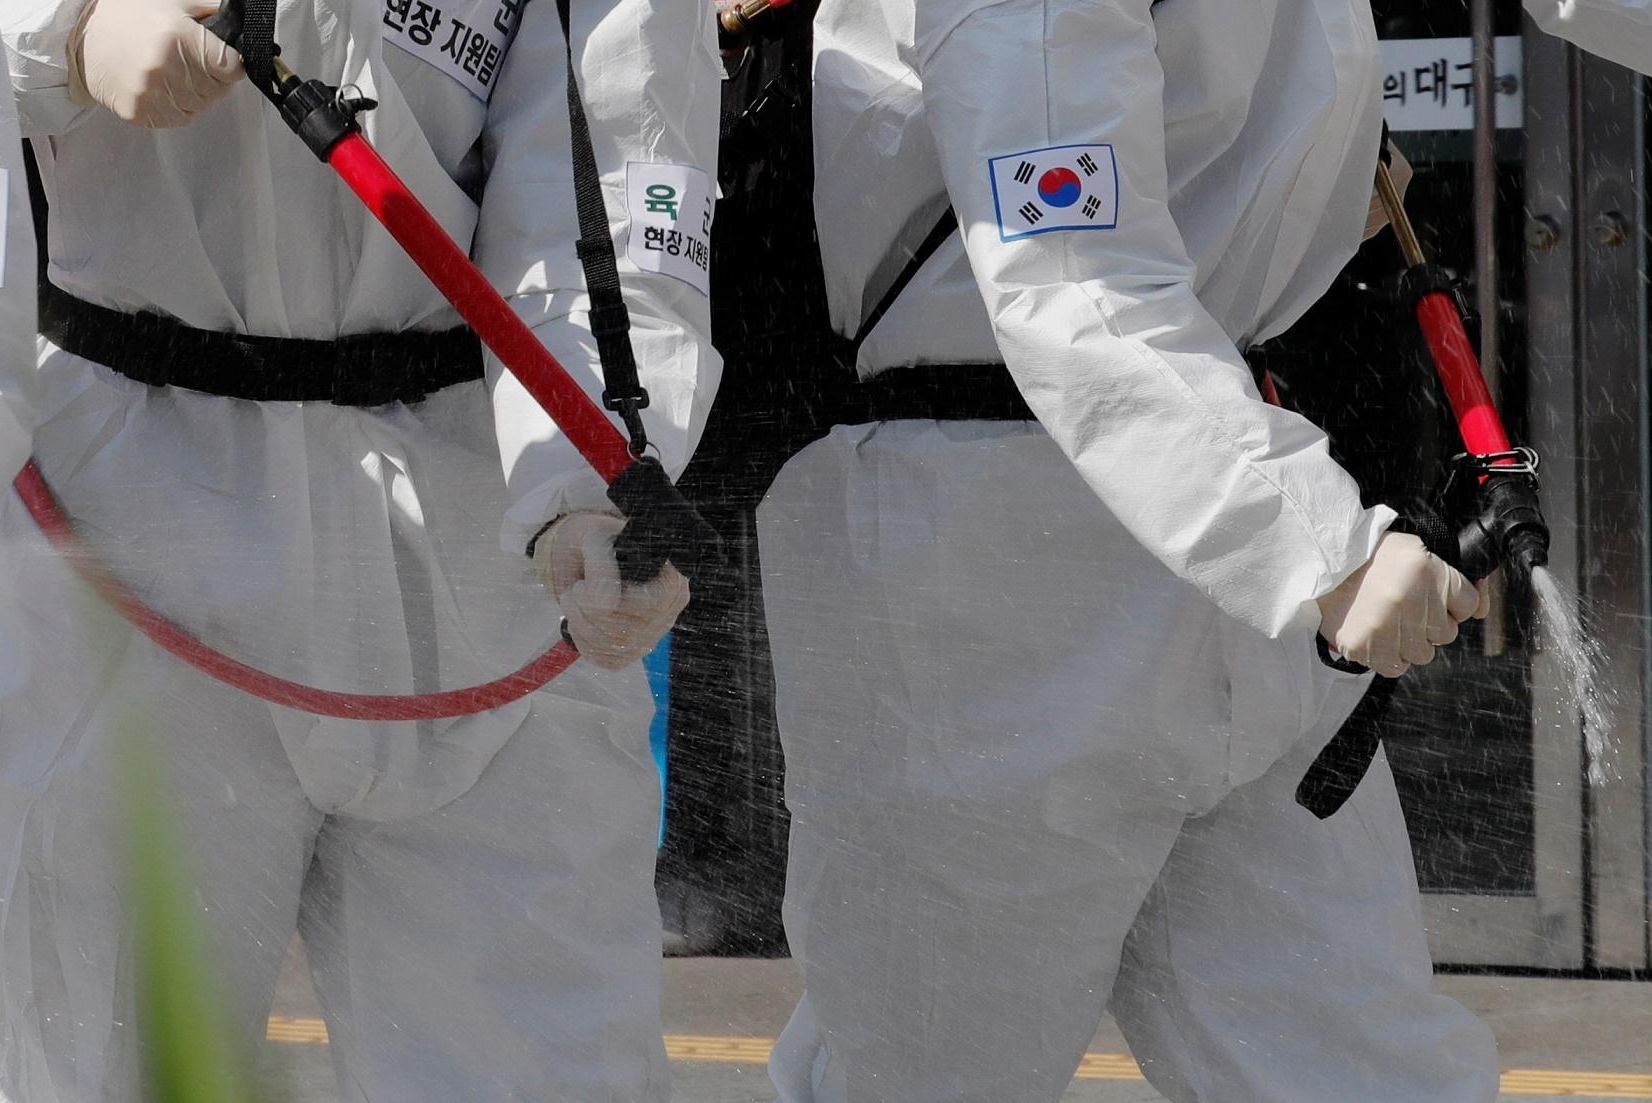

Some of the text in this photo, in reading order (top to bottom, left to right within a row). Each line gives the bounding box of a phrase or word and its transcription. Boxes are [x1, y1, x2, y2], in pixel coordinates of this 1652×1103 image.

[440, 18, 502, 87] 지원팀
[644, 184, 678, 221] 육
[644, 226, 708, 272] 현장 지원팀
